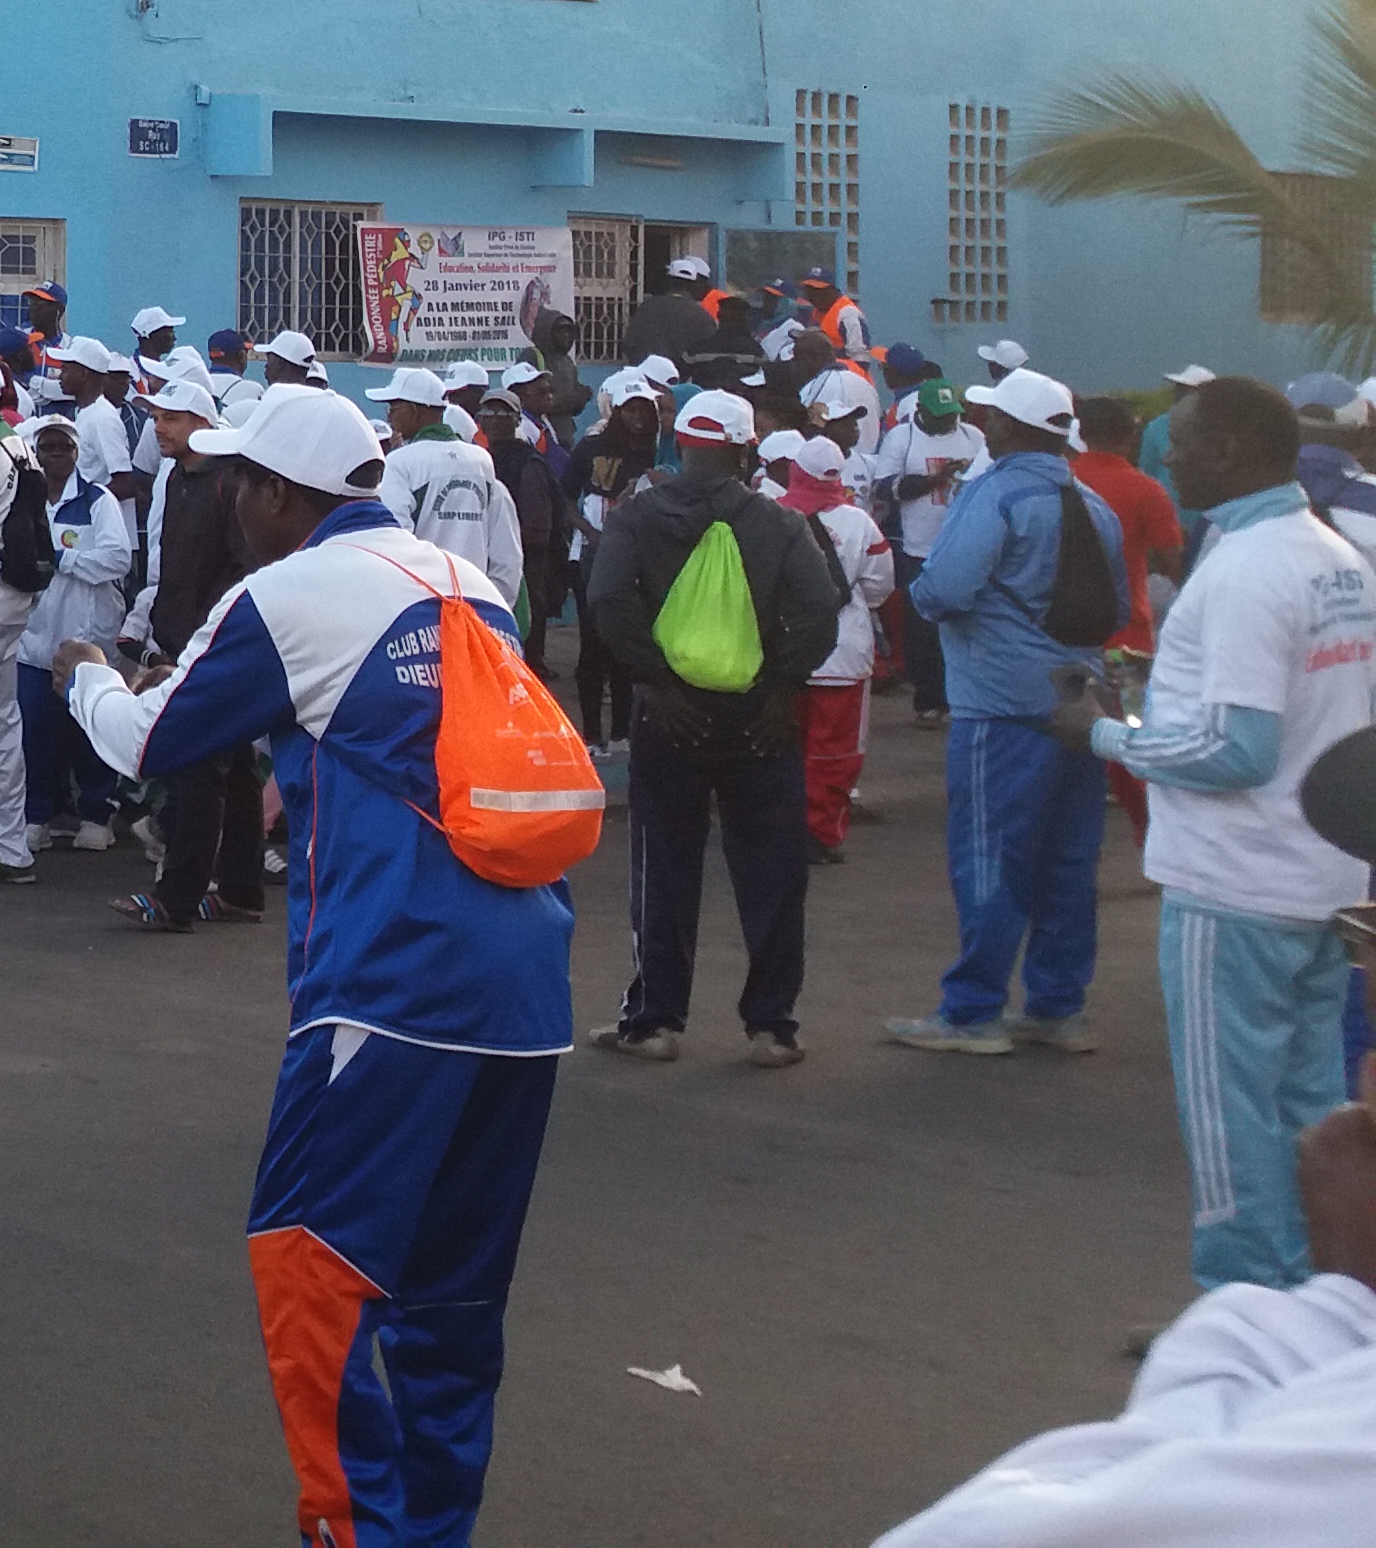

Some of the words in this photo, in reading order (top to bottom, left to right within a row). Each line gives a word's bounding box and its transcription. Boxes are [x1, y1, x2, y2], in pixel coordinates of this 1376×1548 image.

[487, 231, 506, 241] IPG
[515, 231, 535, 241] ISTI
[364, 233, 379, 286] PÉDESTRE
[423, 279, 439, 292] 28
[443, 279, 487, 294] Janvier
[489, 279, 521, 292] 2018
[436, 301, 449, 313] LA
[450, 300, 499, 313] MÉMOIRE
[501, 301, 514, 312] DE
[416, 316, 445, 327] ADJA
[448, 316, 490, 327] JEANNE
[493, 315, 516, 326] SALL
[386, 631, 421, 660] CLUB
[395, 663, 443, 689] DIEU
